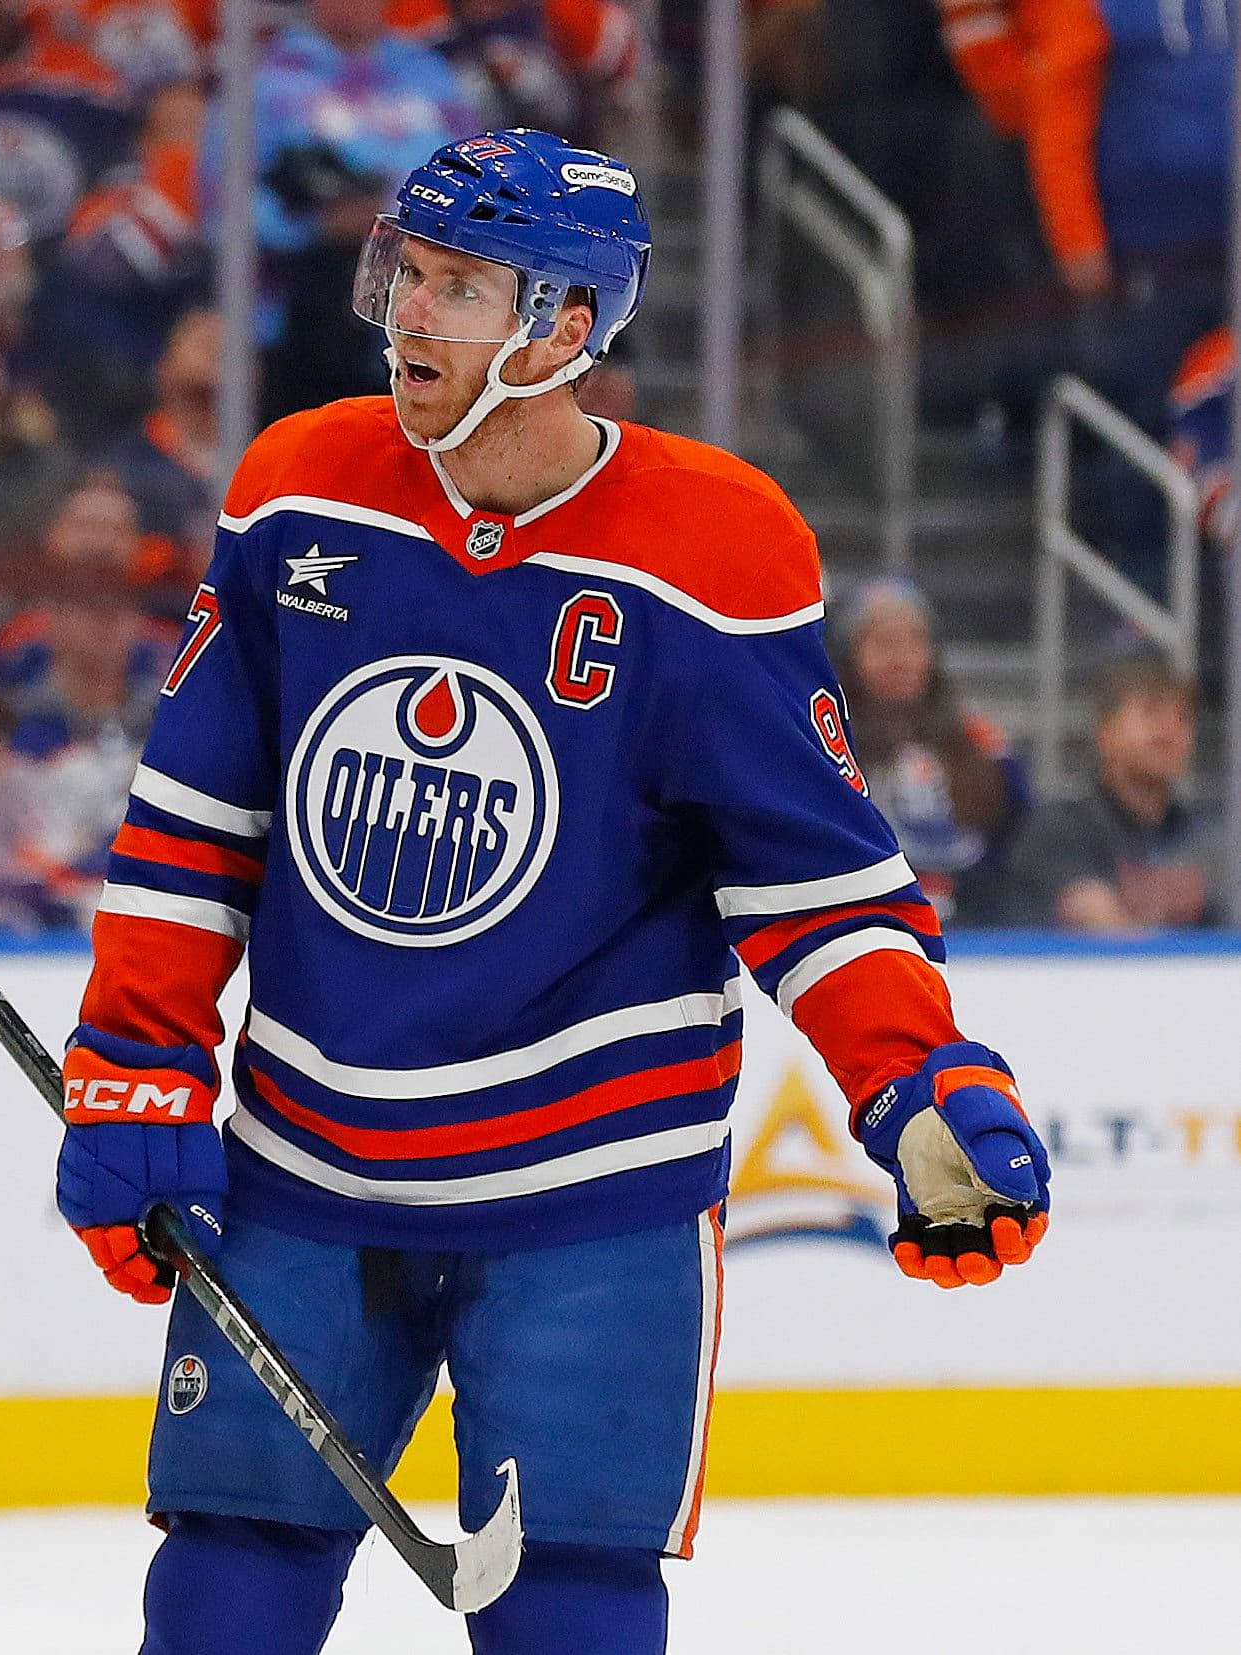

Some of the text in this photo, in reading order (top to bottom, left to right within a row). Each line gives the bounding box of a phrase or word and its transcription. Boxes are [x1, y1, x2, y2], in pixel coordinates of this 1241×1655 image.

[410, 184, 455, 208] CCM
[544, 589, 624, 710] C
[809, 684, 869, 798] 9
[321, 747, 518, 918] OILERS
[64, 1078, 192, 1118] CCM
[865, 1084, 897, 1126] CCM
[189, 1204, 223, 1236] CCM
[215, 1304, 327, 1452] CCM
